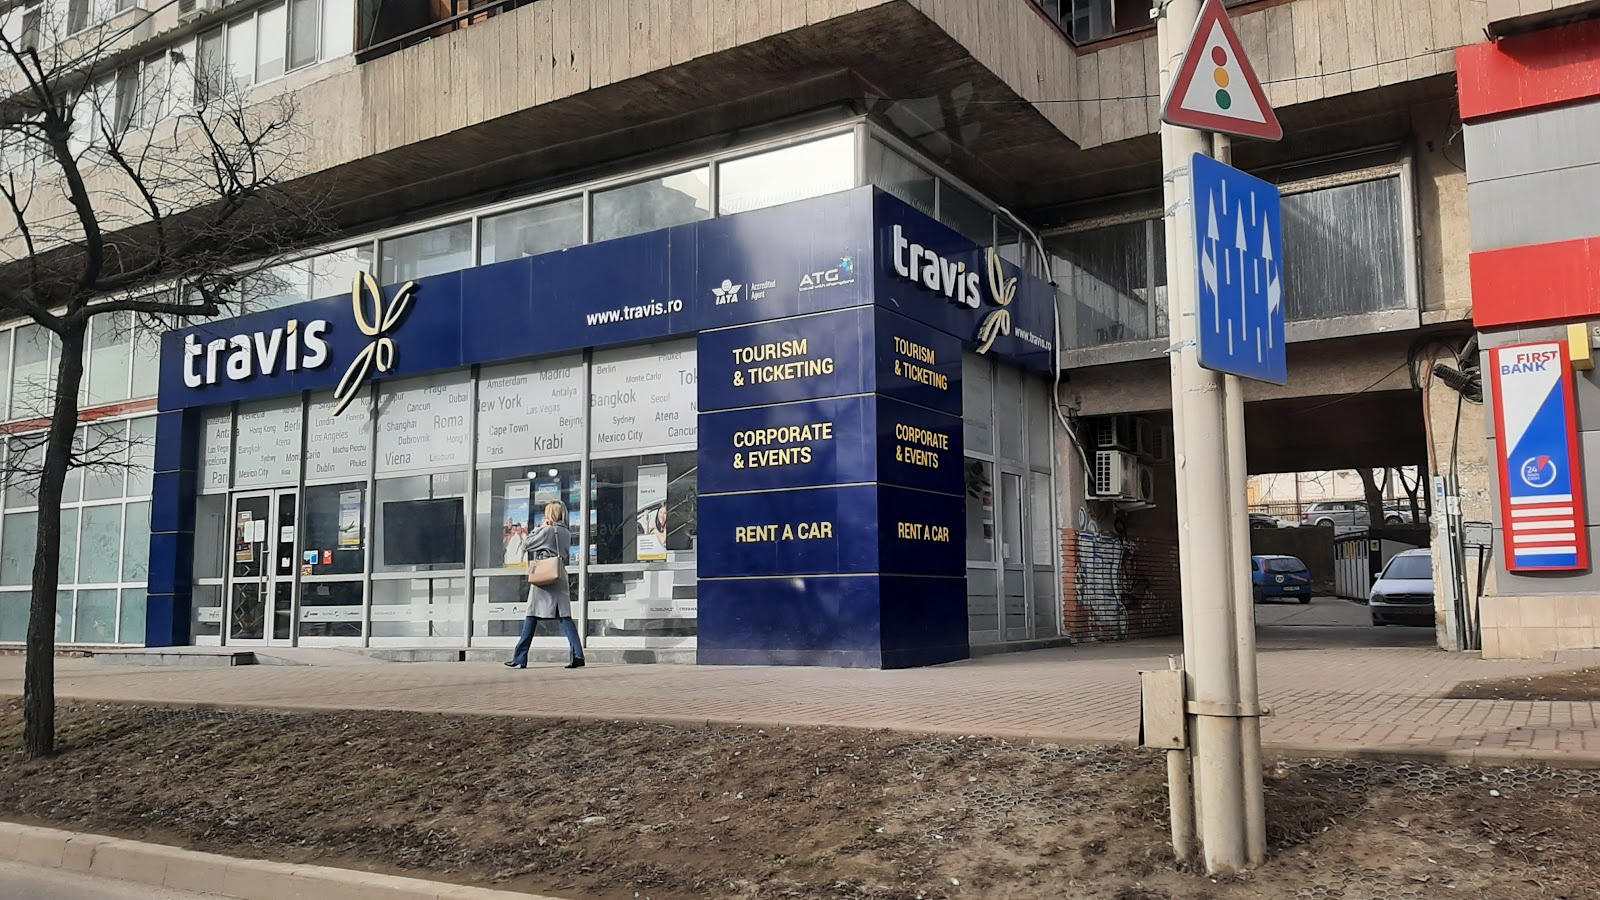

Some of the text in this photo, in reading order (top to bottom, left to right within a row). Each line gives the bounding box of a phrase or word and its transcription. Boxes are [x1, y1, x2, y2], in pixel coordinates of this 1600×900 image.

[892, 224, 981, 309] travis
[799, 268, 839, 287] ATG
[751, 279, 777, 291] Accredited
[715, 293, 739, 306] IATA
[751, 290, 766, 300] Agent
[586, 299, 683, 326] www.travis.ro
[1014, 326, 1052, 351] www.travis.ro
[183, 319, 328, 388] travis
[732, 338, 808, 365] TOURISM
[894, 336, 935, 365] TOURISM
[1516, 350, 1558, 364] FIRST
[539, 368, 571, 382] Madrid
[597, 364, 617, 375] Berlin
[732, 357, 834, 387] & TICKETING
[894, 359, 948, 391] & TICKETING
[1501, 361, 1546, 376] BANK
[487, 376, 528, 389] Amsterdam
[625, 371, 662, 384] Monte Carlo
[678, 368, 698, 386] Tok
[448, 392, 469, 404] Dubai
[551, 386, 577, 398] Antalya
[590, 388, 637, 409] Bangkok
[650, 392, 671, 404] Seoul
[407, 402, 431, 413] Cancun
[498, 393, 522, 410] York
[526, 404, 561, 416] Las Vegas
[655, 411, 679, 422] Atena
[284, 419, 302, 433] Berli
[315, 418, 335, 428] Londra
[387, 419, 418, 433] Shanghai
[433, 415, 464, 430] Roma
[612, 414, 636, 426] Sydney
[249, 424, 277, 436] Hong Kong
[310, 429, 349, 443] Los Angeles
[489, 422, 529, 438] Cape Town
[597, 430, 644, 443] Mexico City
[733, 422, 834, 448] CORPORATE
[895, 423, 949, 450] CORPORATE
[398, 432, 431, 446] Dubrovnik
[534, 433, 564, 451] Krabi
[217, 445, 229, 453] Vega
[238, 443, 261, 456] Bangkok
[487, 444, 504, 455] Paris
[349, 459, 367, 468] Phuket
[385, 452, 411, 466] Viena
[732, 446, 812, 469] & EVENTS
[895, 445, 939, 468] & EVENTS
[238, 468, 269, 479] Mexico City
[316, 462, 335, 473] Dublin
[1526, 465, 1538, 474] 24
[211, 470, 229, 484] Pari
[735, 521, 833, 543] RENT A CAR
[897, 521, 950, 542] RENT A CAR
